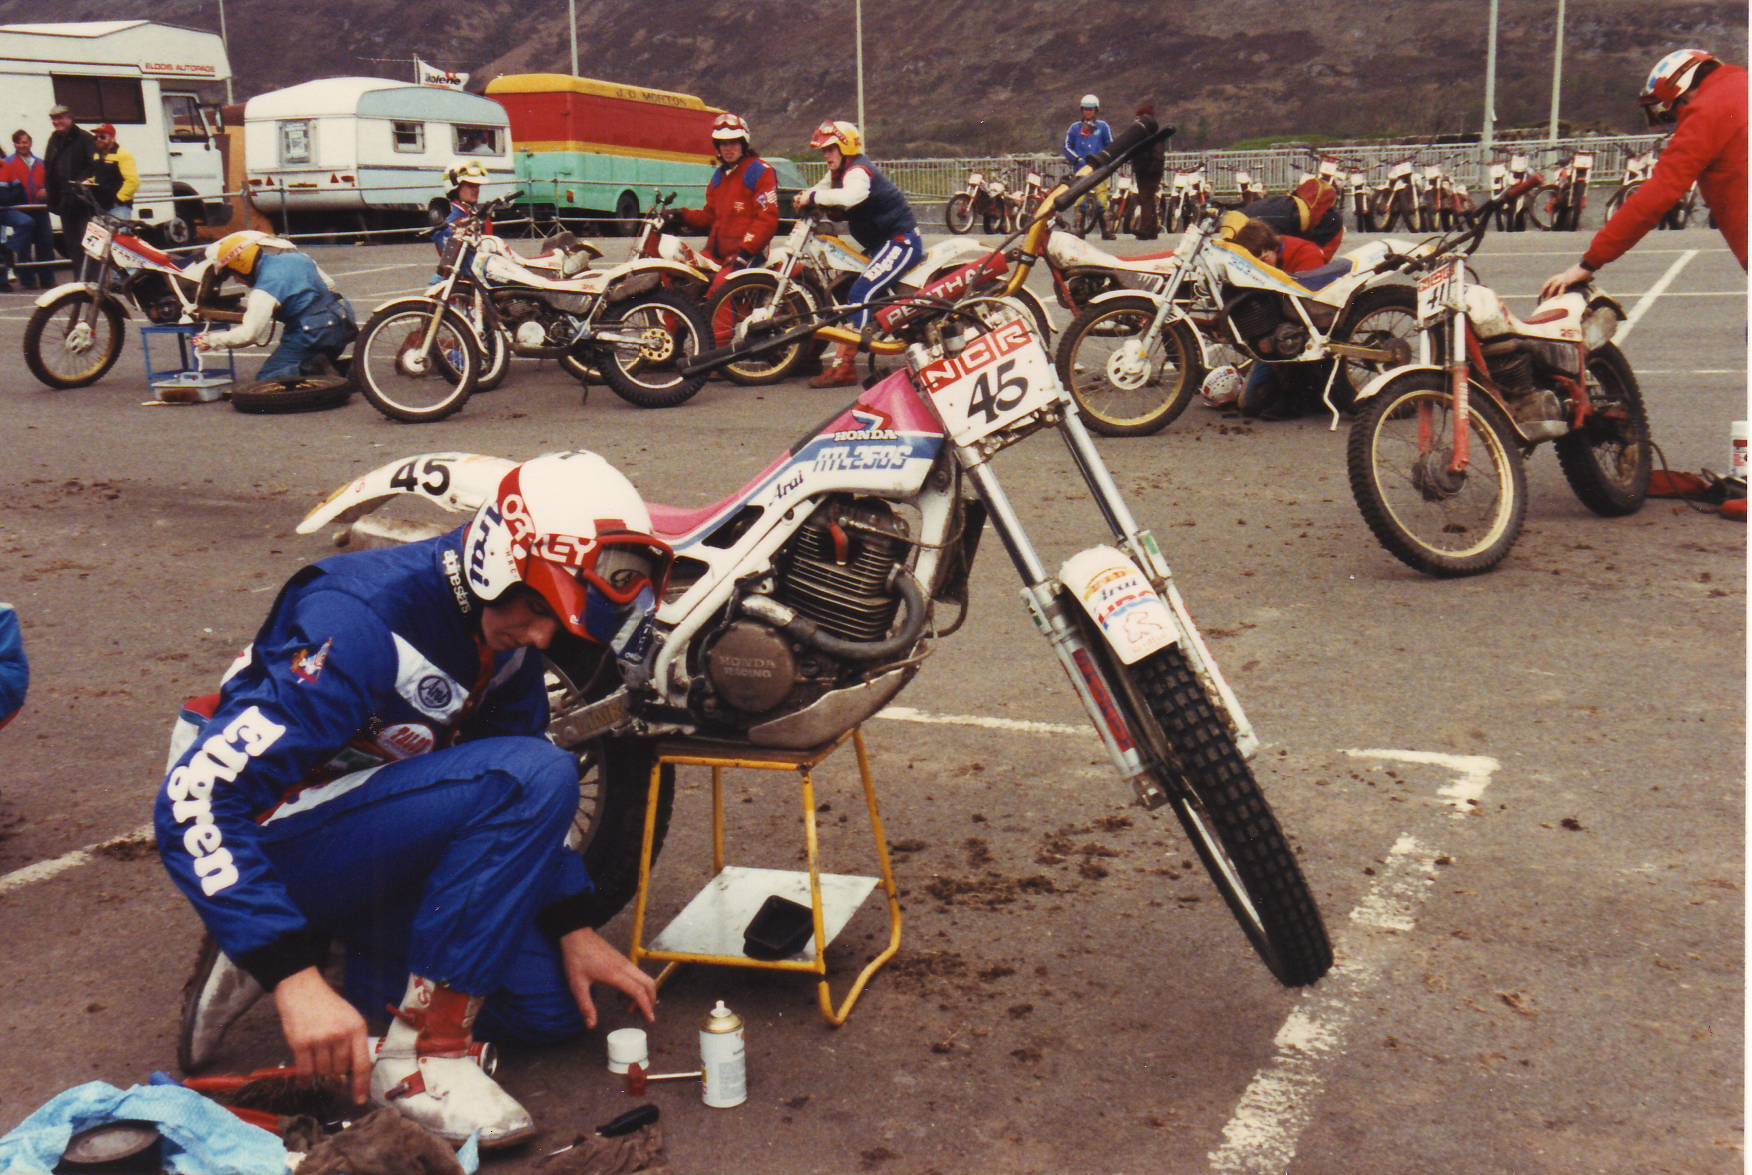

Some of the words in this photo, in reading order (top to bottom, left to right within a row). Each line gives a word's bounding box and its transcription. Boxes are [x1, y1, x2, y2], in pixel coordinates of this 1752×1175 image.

[926, 323, 1027, 389] NCR
[967, 358, 1029, 425] 45
[834, 429, 899, 442] HONDA
[389, 458, 458, 496] 45
[719, 656, 777, 669] HONDA
